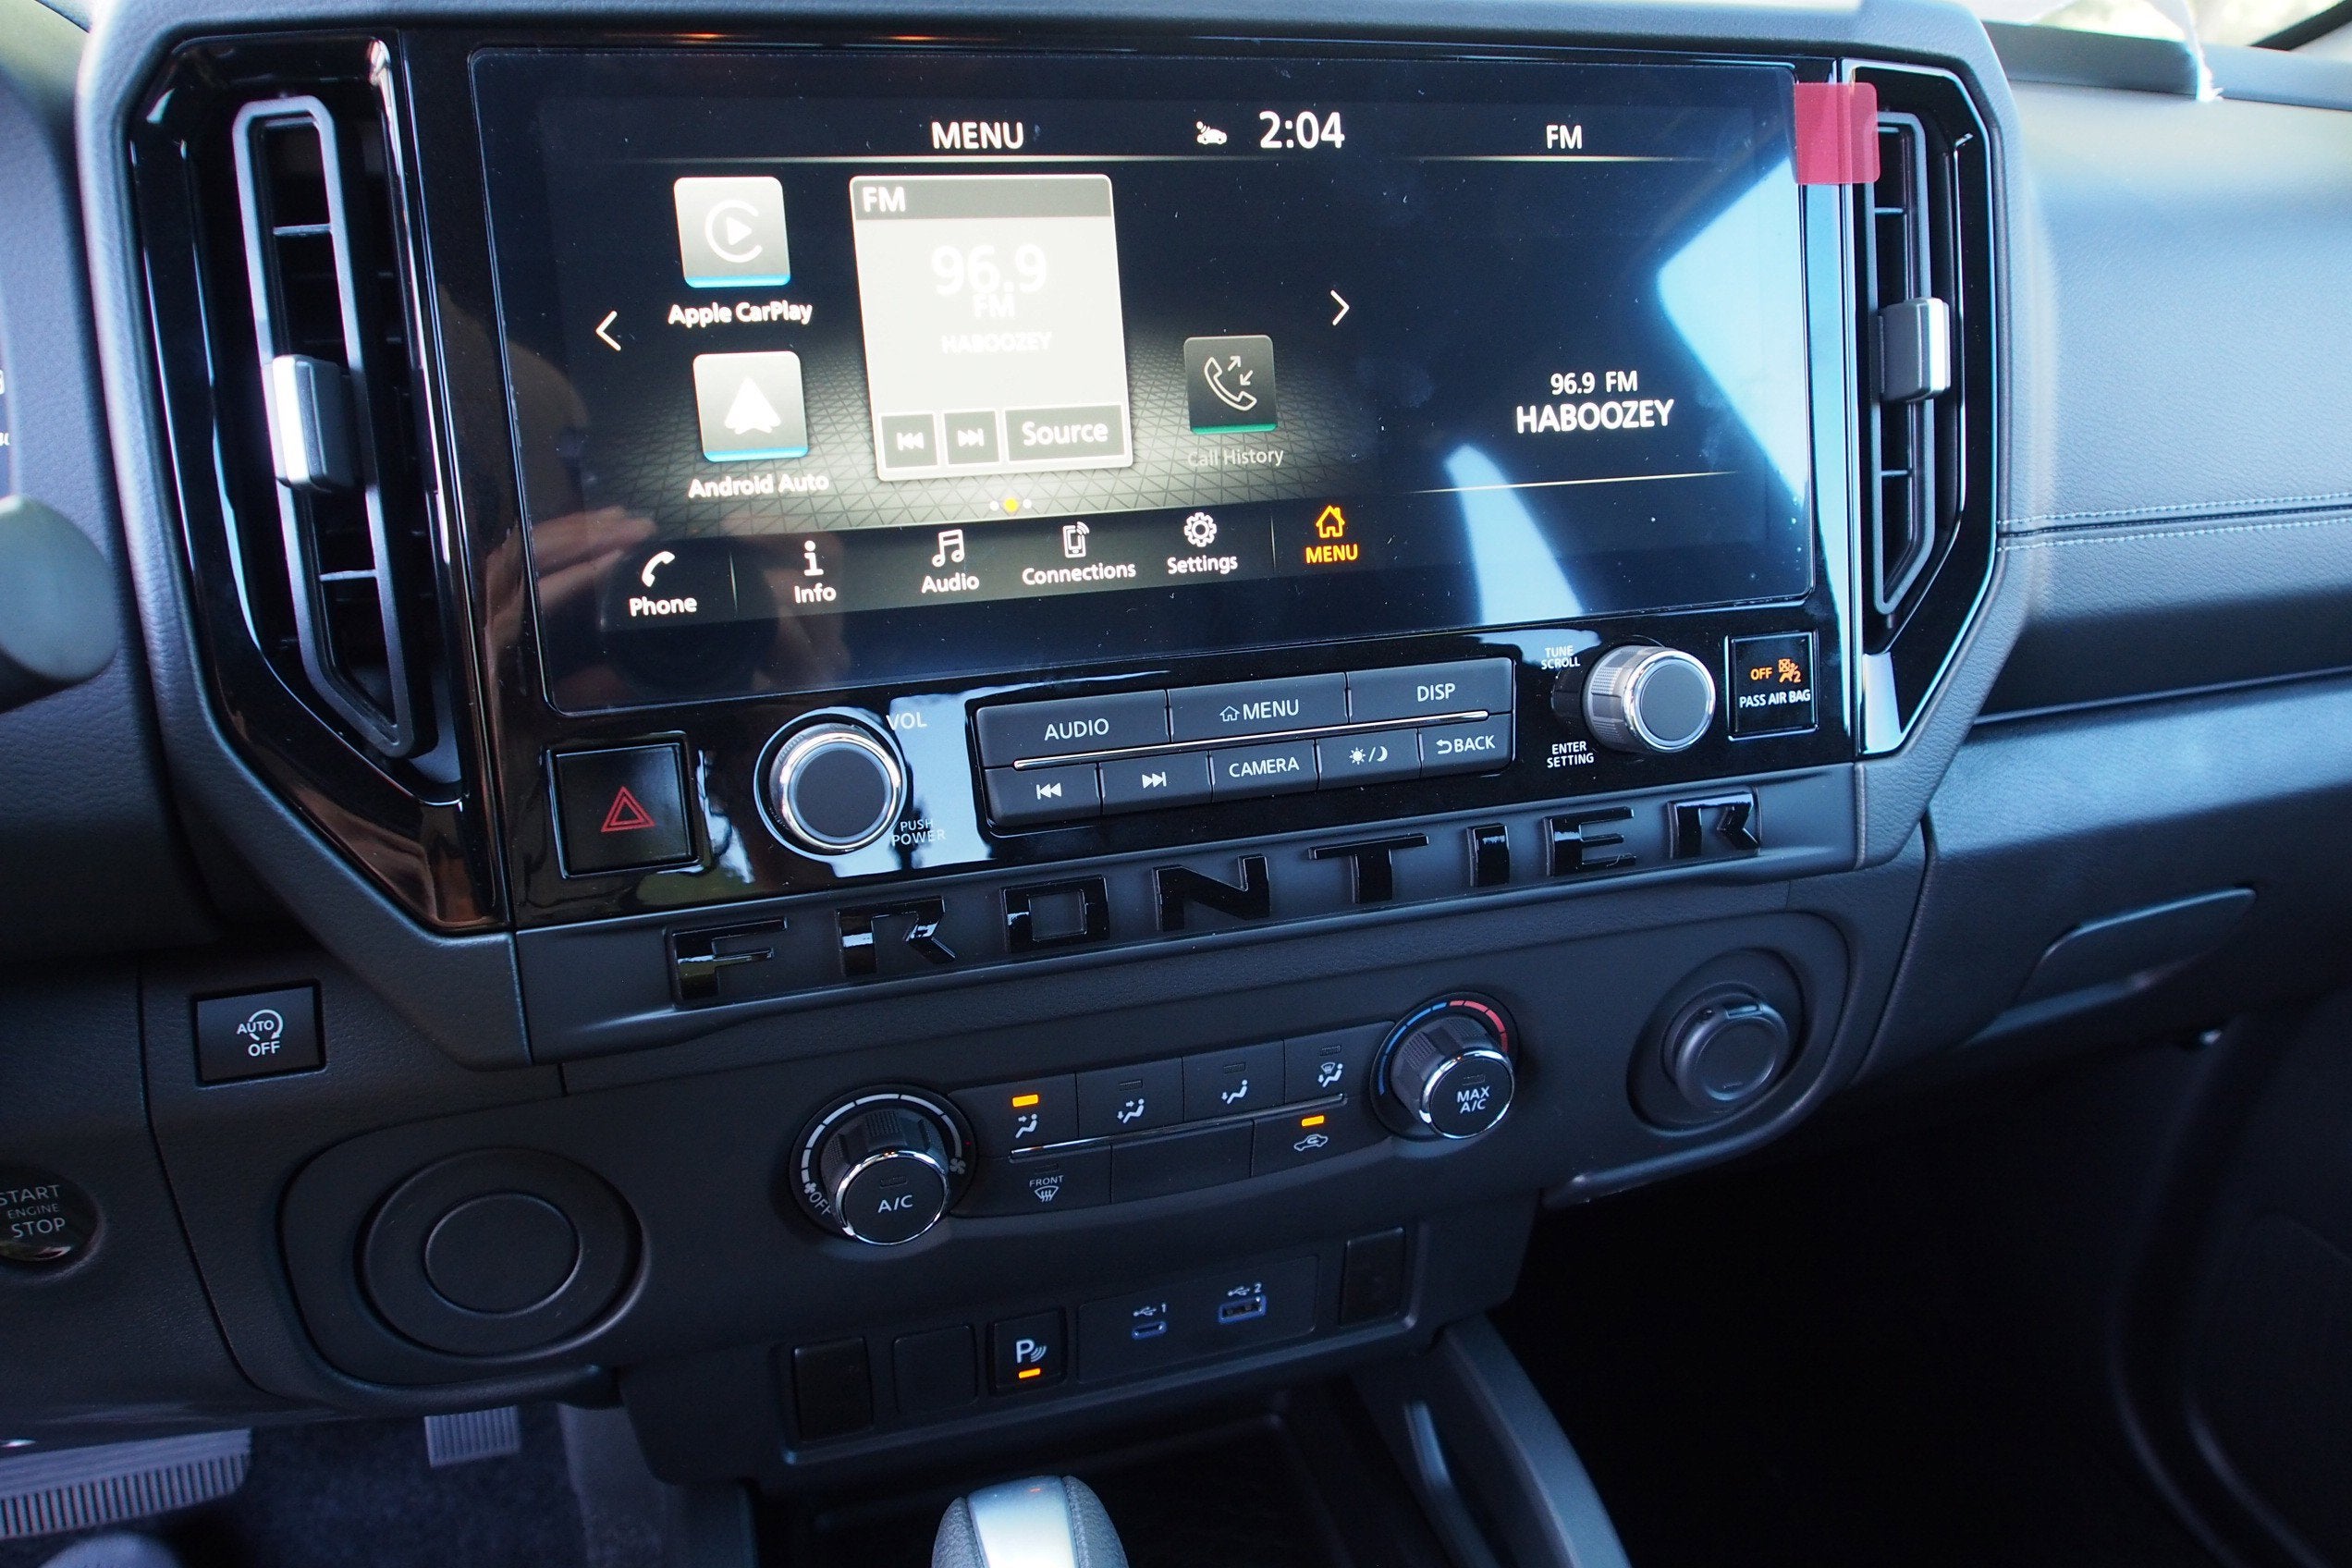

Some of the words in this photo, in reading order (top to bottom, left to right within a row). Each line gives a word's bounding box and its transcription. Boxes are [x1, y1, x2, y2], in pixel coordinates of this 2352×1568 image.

[931, 121, 1024, 150] MENU
[1259, 111, 1345, 149] 2:04
[1546, 125, 1583, 150] FM
[862, 186, 906, 213] FM
[931, 243, 1047, 296] 96.9
[668, 303, 732, 327] Apple
[735, 300, 814, 325] CarPlay
[973, 293, 1015, 318] FM
[940, 331, 1052, 354] HABOOZEY
[1550, 372, 1596, 395] 96.9
[1605, 371, 1638, 392] FM
[1516, 399, 1674, 434] HABOOZEY
[1022, 421, 1109, 447] Source
[1187, 450, 1220, 467] Call
[1223, 448, 1284, 467] History
[688, 474, 775, 499] Android
[778, 473, 830, 494] Auto
[1167, 553, 1238, 576] Settings
[1305, 543, 1359, 565] MENU
[921, 573, 980, 594] Audio
[1022, 562, 1136, 586] Connections
[794, 582, 837, 604] Info
[629, 596, 698, 618] Phone
[1544, 645, 1574, 659] TUNE
[1540, 656, 1581, 670] SCROLL
[1750, 667, 1772, 680] OFF
[1416, 682, 1456, 703] DISP
[1739, 693, 1766, 708] PASS
[1768, 692, 1787, 705] AIR
[1789, 689, 1810, 704] BAG
[1243, 699, 1300, 721] MENU
[886, 712, 927, 730] VOL
[1044, 717, 1109, 741] AUDIO
[1453, 735, 1496, 753] BACK
[1551, 741, 1587, 755] ENTER
[1229, 756, 1300, 778] CAMERA
[1547, 752, 1595, 769] SETTING
[900, 818, 934, 832] PUSH
[891, 828, 947, 847] POWER
[668, 790, 1758, 1001] FRONTIER
[237, 1020, 275, 1035] AUTO
[248, 1041, 280, 1057] OFF
[1456, 1086, 1490, 1104] MAX
[1459, 1098, 1487, 1114] A/C
[1029, 1174, 1064, 1187] FRONT
[7, 1203, 59, 1219] ENGINE
[877, 1194, 913, 1214] A/C
[11, 1217, 66, 1238] STOP
[1255, 1282, 1262, 1293] 2
[1161, 1303, 1167, 1314] 1
